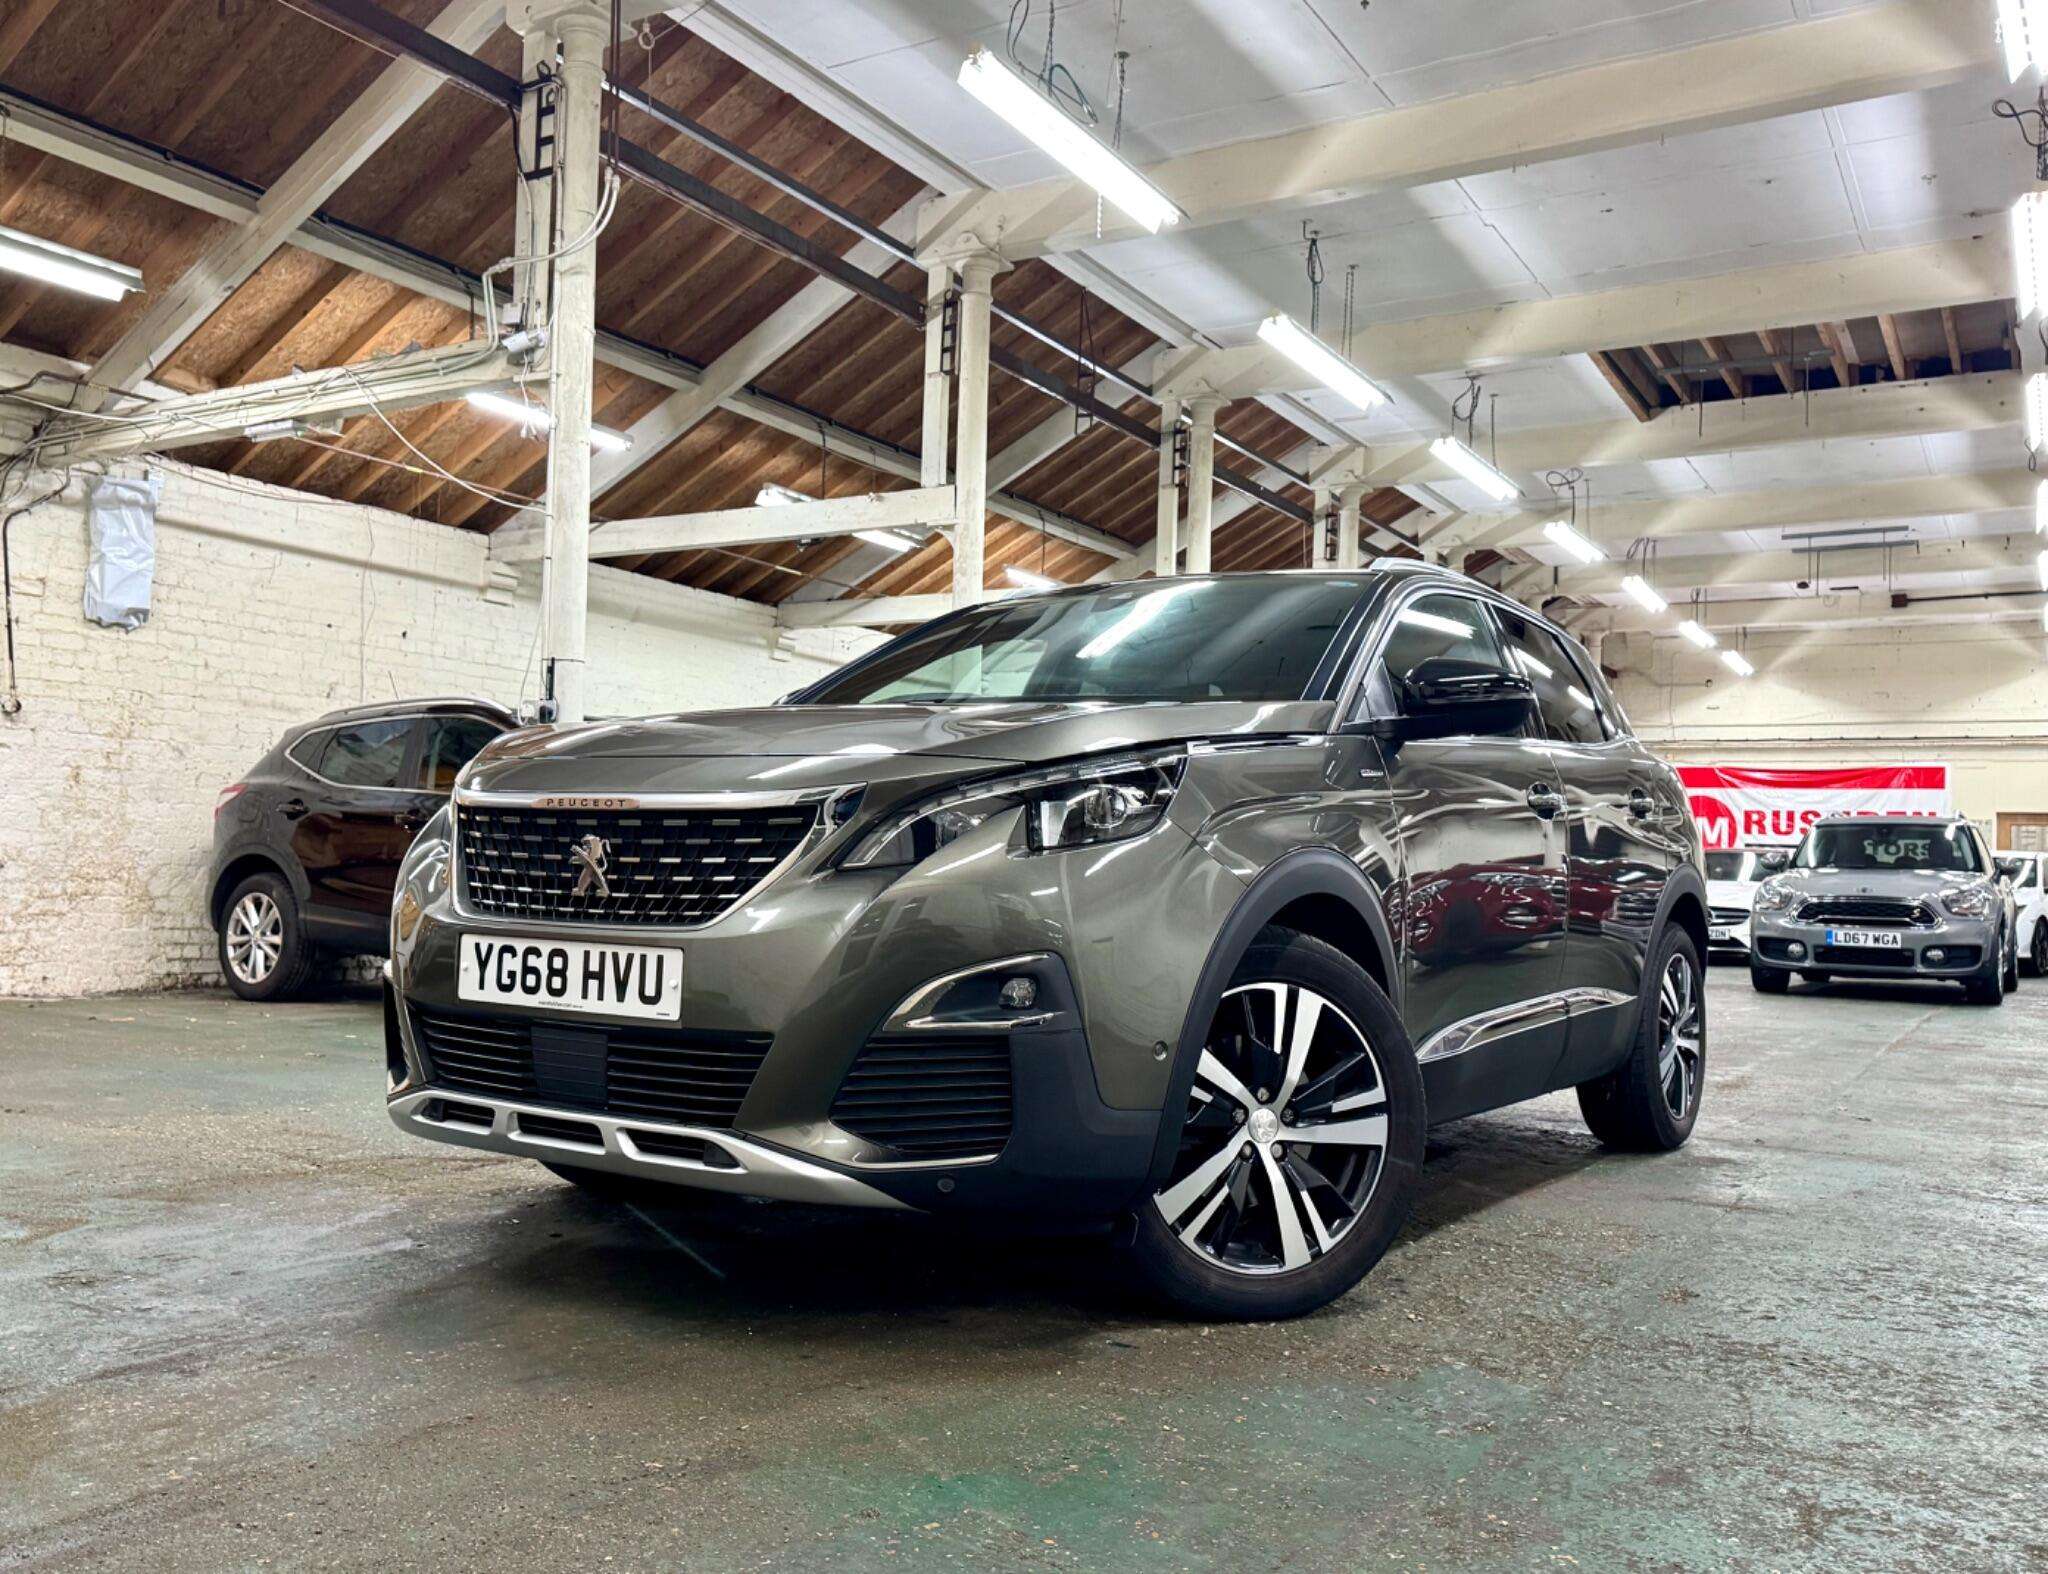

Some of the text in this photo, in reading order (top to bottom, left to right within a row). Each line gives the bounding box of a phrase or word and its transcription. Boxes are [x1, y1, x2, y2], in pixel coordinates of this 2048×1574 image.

[546, 798, 626, 808] PEUGEOT
[1834, 932, 1899, 946] LD67 WGA
[474, 942, 664, 1006] YG68 HVU
